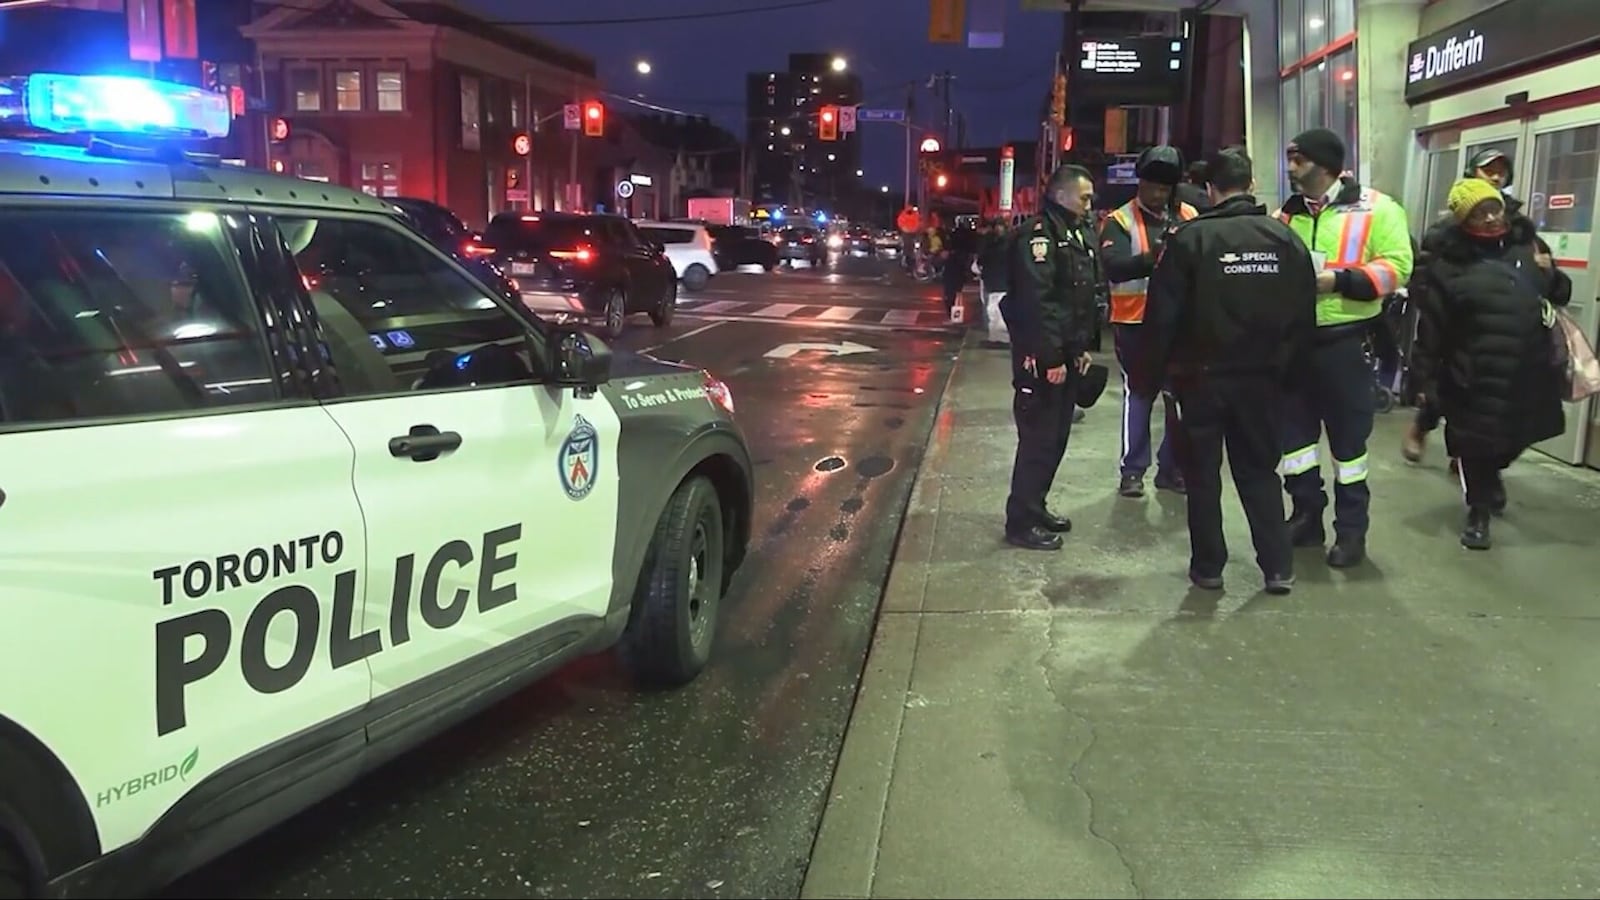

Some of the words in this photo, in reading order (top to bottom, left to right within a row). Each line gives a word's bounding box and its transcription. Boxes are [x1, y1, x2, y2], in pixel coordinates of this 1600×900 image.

[1425, 29, 1484, 79] Dufferin
[1223, 263, 1280, 274] CONSTABLE
[1242, 252, 1279, 261] SPECIAL
[621, 395, 639, 409] To
[636, 393, 667, 407] Serve
[665, 389, 677, 402] &
[153, 530, 343, 605] TORONTO
[155, 522, 523, 737] POLICE
[96, 764, 179, 809] HYBRID
